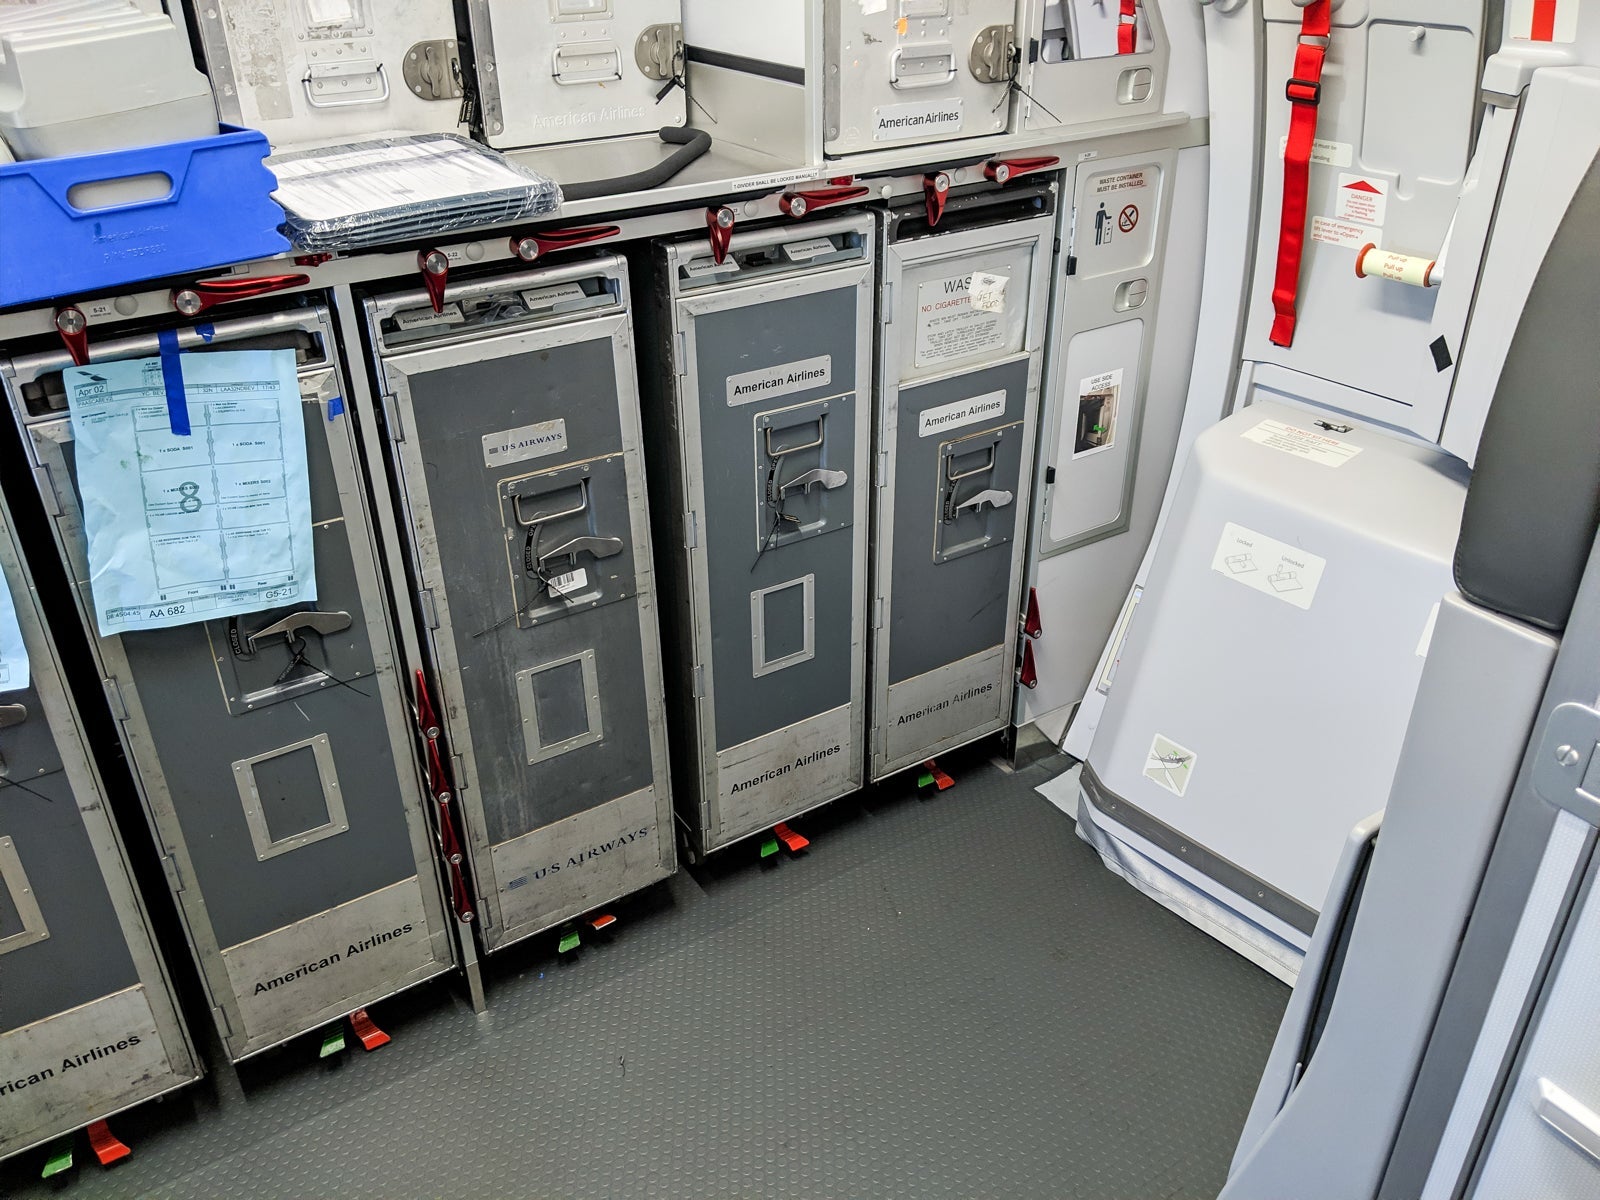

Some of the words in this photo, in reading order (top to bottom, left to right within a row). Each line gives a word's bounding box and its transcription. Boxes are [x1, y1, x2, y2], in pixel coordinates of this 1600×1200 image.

[533, 111, 596, 129] American
[600, 105, 646, 121] Airlines
[878, 115, 924, 129] American
[925, 111, 959, 124] Airlines
[777, 176, 794, 184] LOCKED
[796, 172, 818, 181] MANUALLY
[1100, 176, 1116, 184] WASTE
[1116, 172, 1143, 182] CONTAINER
[1118, 180, 1144, 188] INSTALLED
[1350, 194, 1372, 202] DANGER
[1337, 224, 1364, 236] emergency
[1323, 234, 1340, 242] release
[530, 294, 556, 302] American
[558, 289, 579, 298] Airlines
[921, 304, 932, 312] NO
[402, 315, 432, 324] American
[432, 311, 458, 320] Airlines
[734, 377, 784, 396] American
[787, 367, 825, 385] Airlines
[1091, 382, 1111, 390] ACCESS
[78, 387, 91, 396] Apr
[925, 410, 966, 428] American
[969, 400, 1001, 416] Airlines
[518, 433, 562, 448] AIRWAYS
[180, 482, 202, 513] 8
[1236, 538, 1253, 547] Locked
[1282, 555, 1304, 568] Unlocked
[149, 607, 164, 618] AA
[167, 605, 185, 615] 682
[265, 588, 292, 599] G5-21
[230, 628, 242, 655] CLOSED
[897, 700, 949, 726] American
[952, 683, 992, 704] Airlines
[731, 764, 791, 795] American
[794, 745, 840, 769] Airlines
[566, 827, 648, 868] AIRWAYS
[254, 953, 341, 996] American
[346, 922, 413, 958] Airlines
[62, 1036, 141, 1072] Airlines
